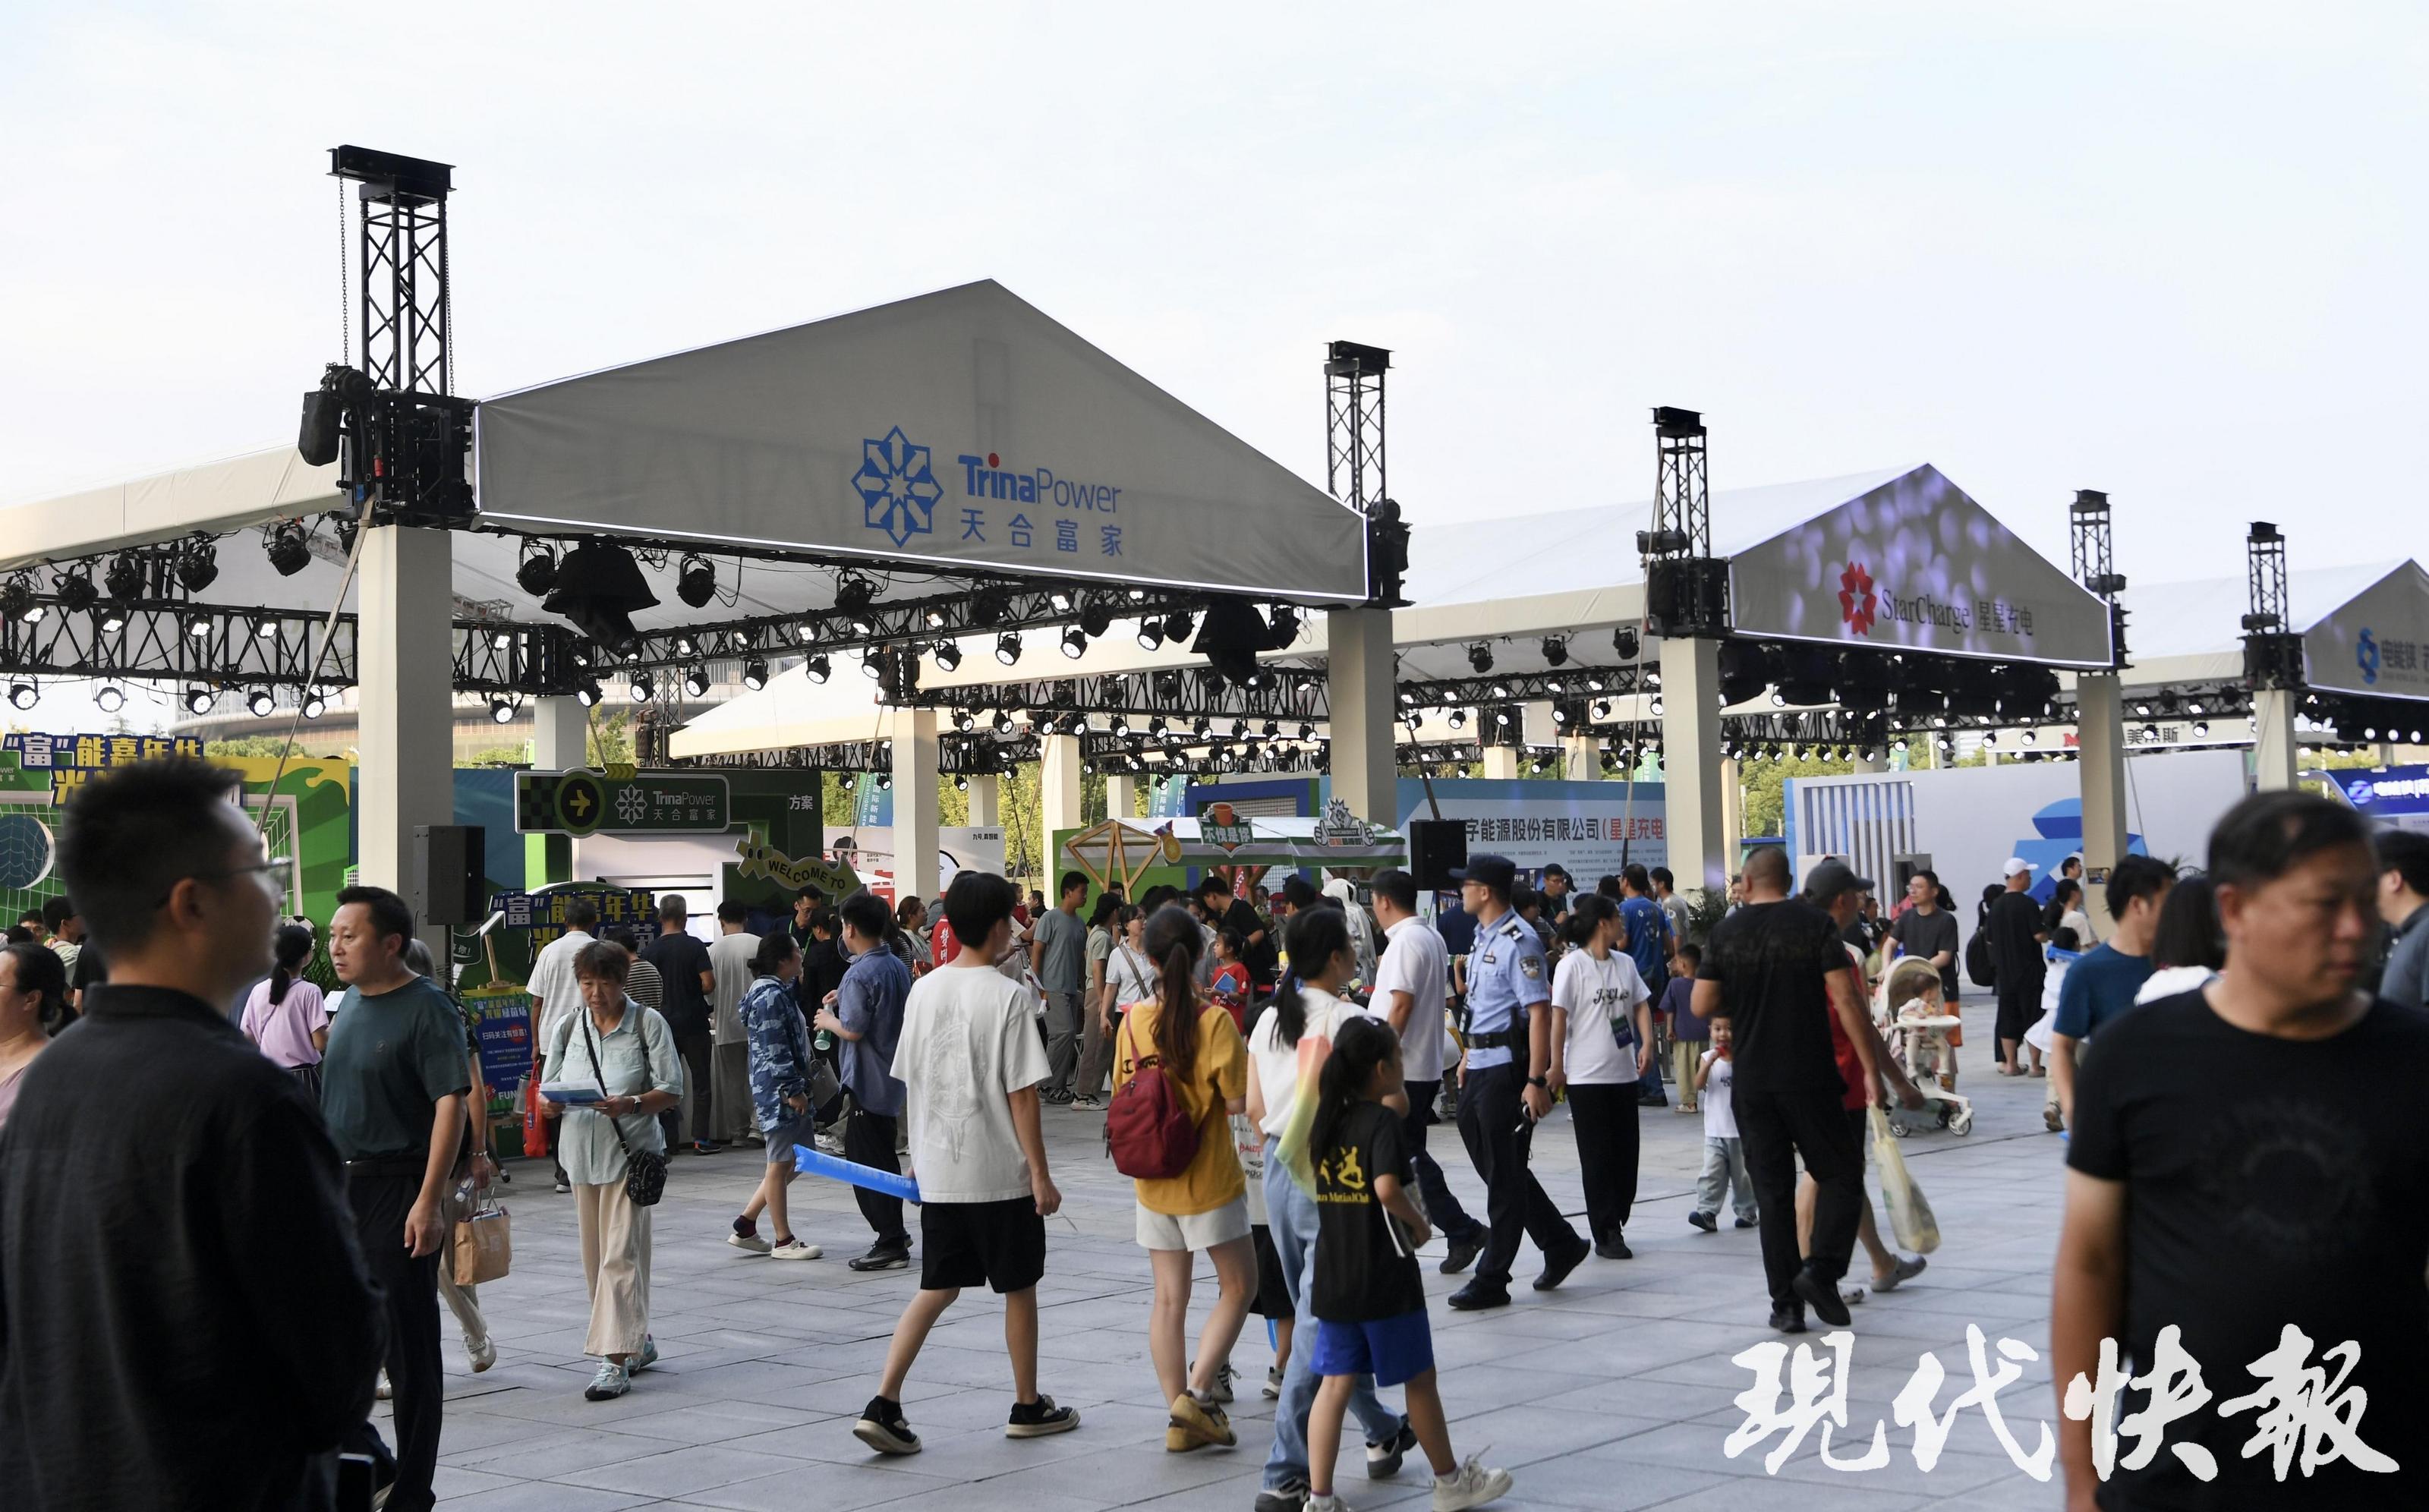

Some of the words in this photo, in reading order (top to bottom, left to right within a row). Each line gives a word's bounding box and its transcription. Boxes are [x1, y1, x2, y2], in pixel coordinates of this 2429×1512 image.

[958, 452, 1122, 514] TrinaPower
[960, 509, 1123, 557] 天合富家
[1882, 589, 1970, 635] StarCharge
[1979, 601, 2034, 636] 星星充电
[653, 790, 717, 805] TrinaPower
[789, 795, 814, 811] 方案
[654, 808, 717, 821] 天合富家
[1415, 817, 1664, 841] 字能源股份有限公司(星星充电
[768, 860, 827, 884] WELCOME
[830, 877, 846, 890] TO
